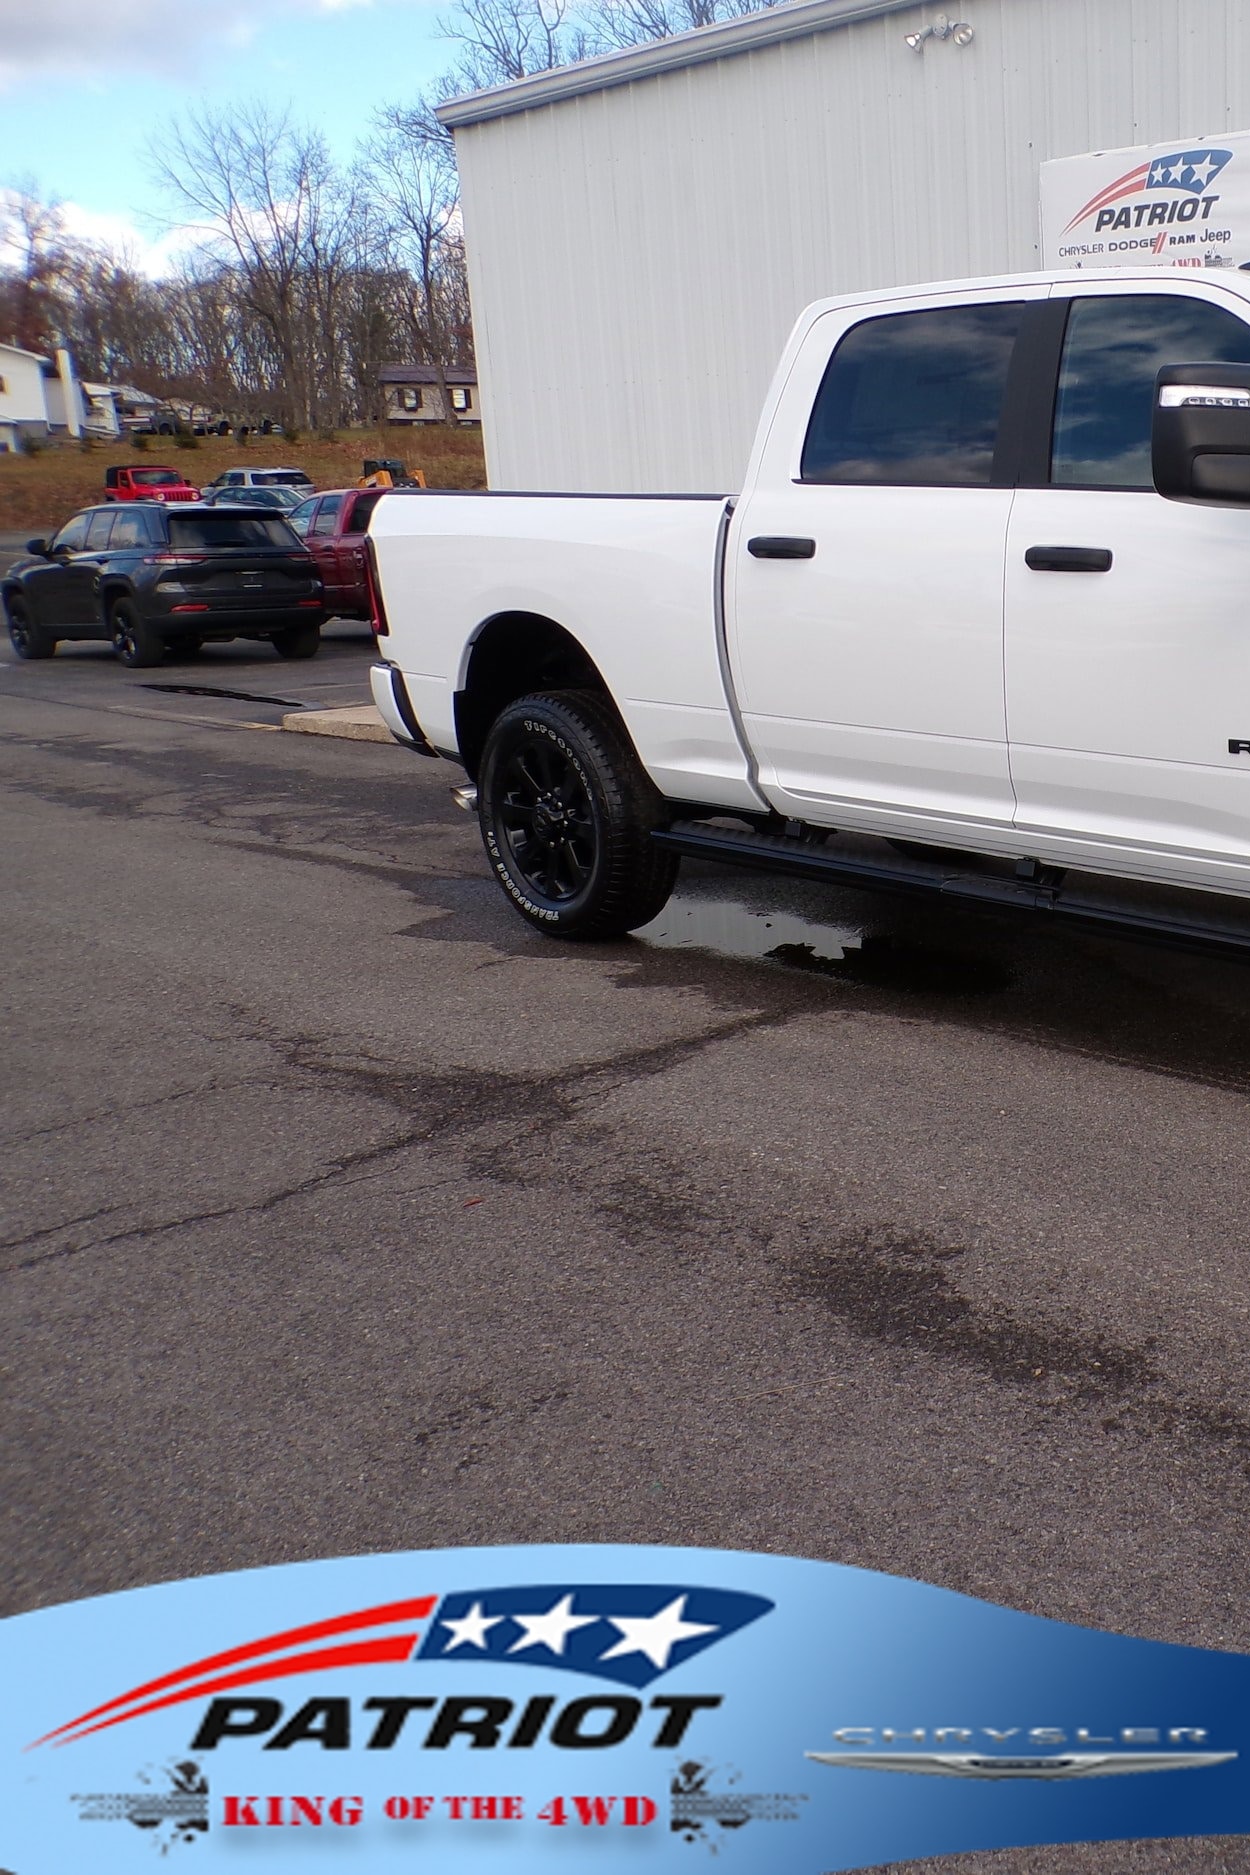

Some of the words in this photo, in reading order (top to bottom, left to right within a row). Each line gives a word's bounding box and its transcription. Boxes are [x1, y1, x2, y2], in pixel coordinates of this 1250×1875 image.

[1095, 195, 1220, 233] PATRIOT
[1058, 243, 1104, 257] CHRYSLER
[1108, 239, 1157, 252] DODGE
[1169, 234, 1196, 246] RAM
[1199, 229, 1231, 244] Jeep
